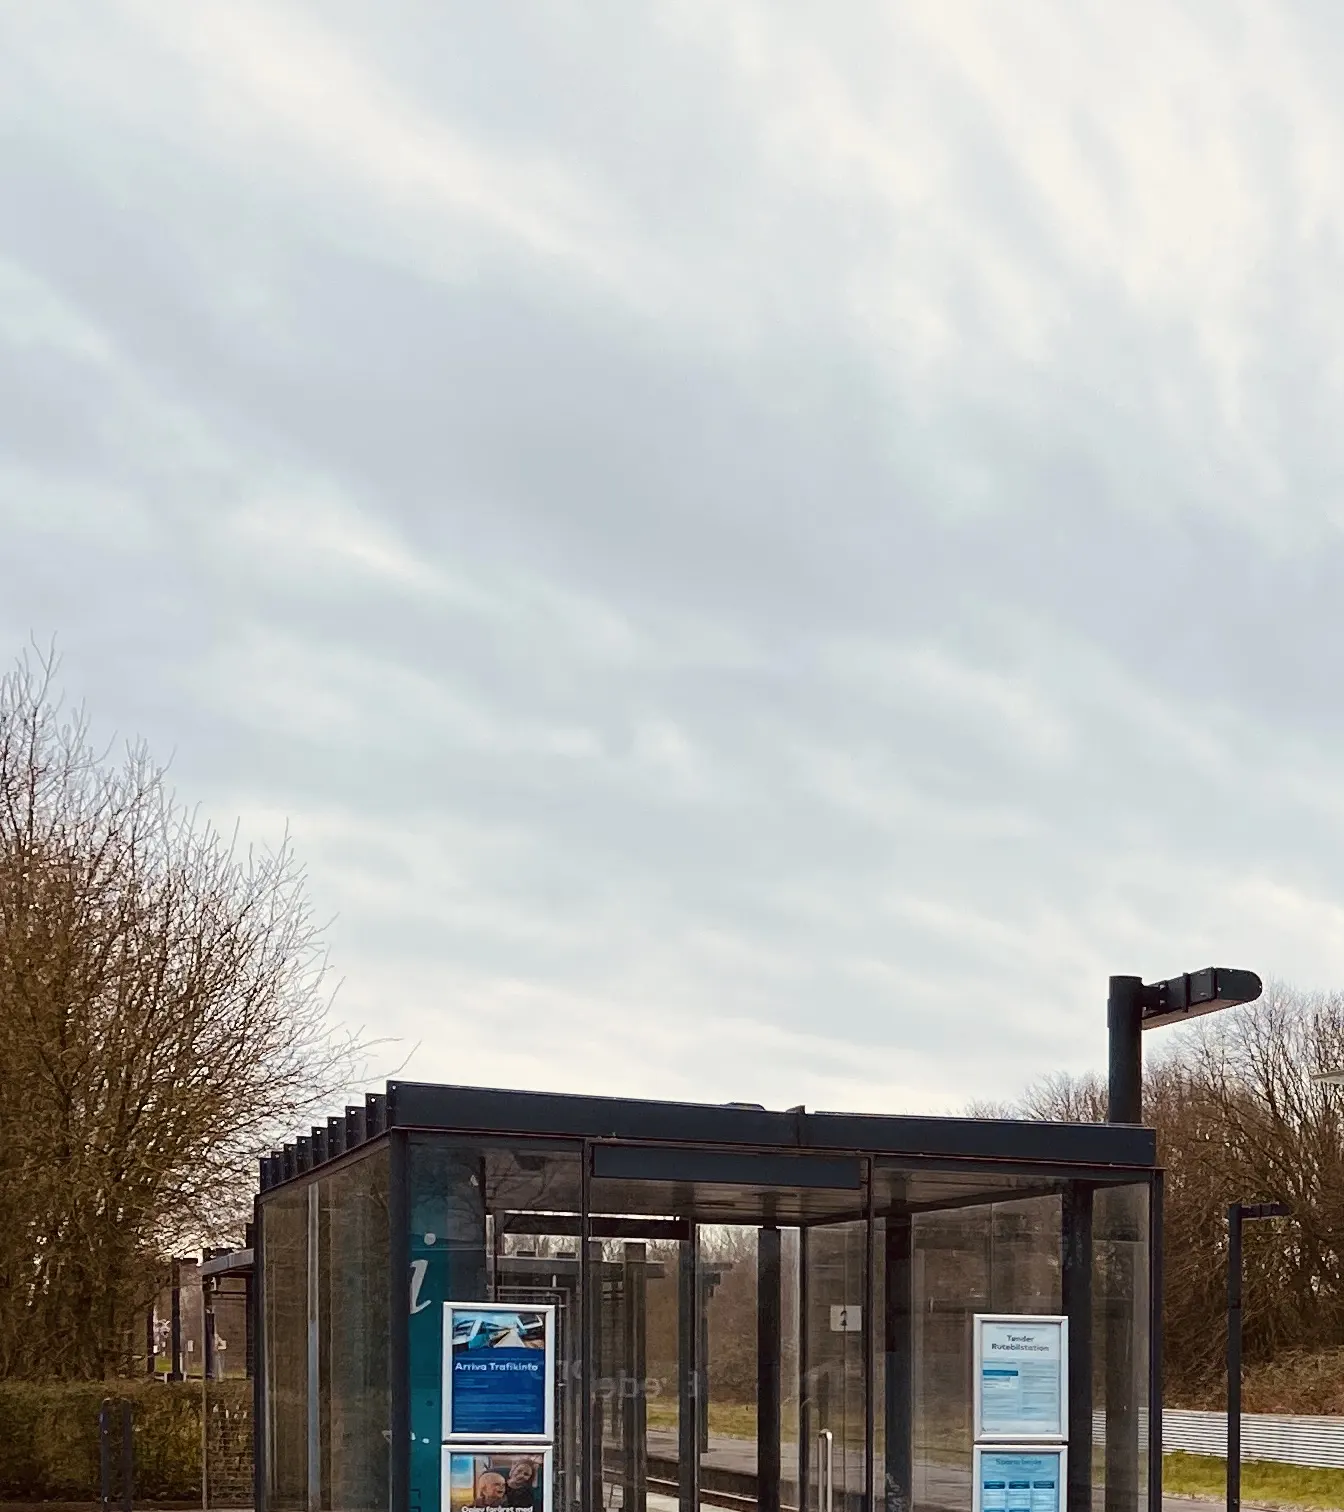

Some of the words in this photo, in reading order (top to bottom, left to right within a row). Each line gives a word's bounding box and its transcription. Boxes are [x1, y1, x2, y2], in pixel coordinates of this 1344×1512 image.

[1006, 1334, 1035, 1343] Tønder
[991, 1343, 1050, 1352] Rutebilstation
[454, 1362, 487, 1371] Arriva
[490, 1362, 539, 1372] Trafikinfo
[515, 1505, 534, 1512] med
